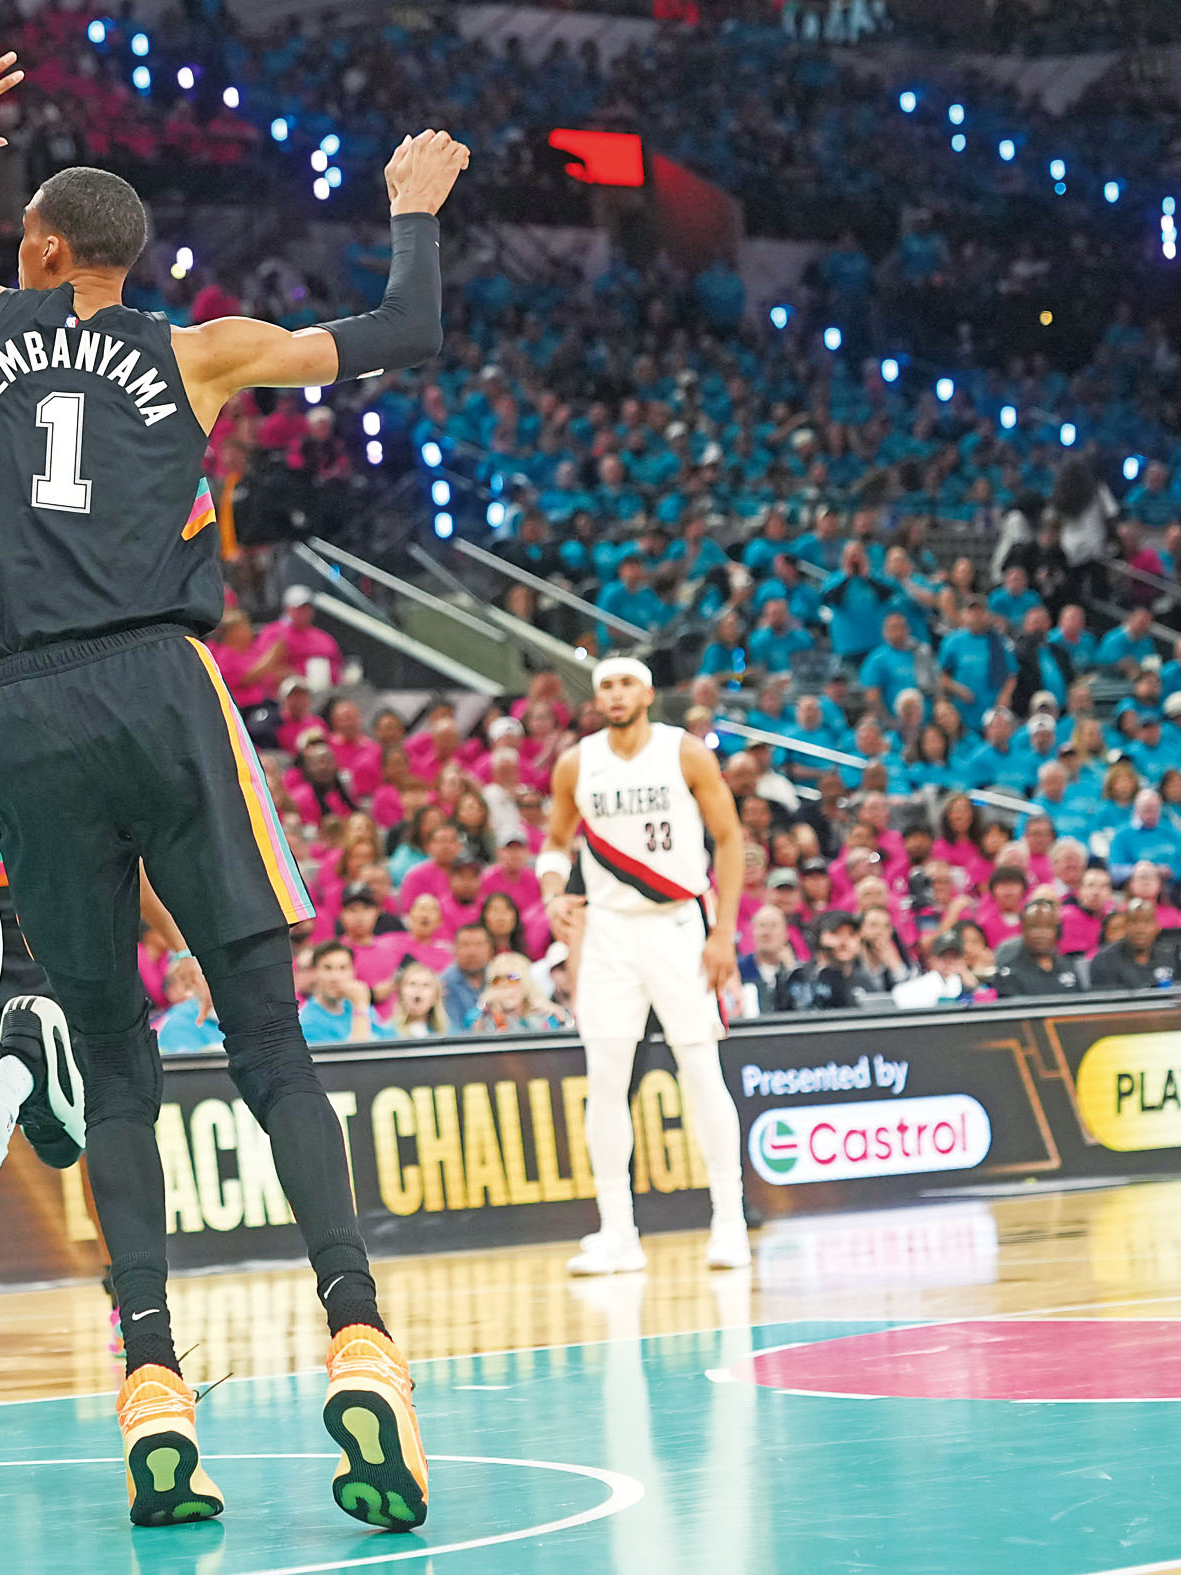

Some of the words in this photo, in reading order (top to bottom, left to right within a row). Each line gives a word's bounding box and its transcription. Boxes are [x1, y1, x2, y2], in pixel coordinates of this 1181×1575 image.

[31, 391, 92, 514] 1
[591, 786, 670, 818] BLAZERS
[645, 821, 672, 852] 33
[741, 1055, 871, 1097] Presented
[873, 1054, 909, 1095] by
[1116, 1069, 1181, 1113] PLA
[809, 1112, 967, 1165] Castrol
